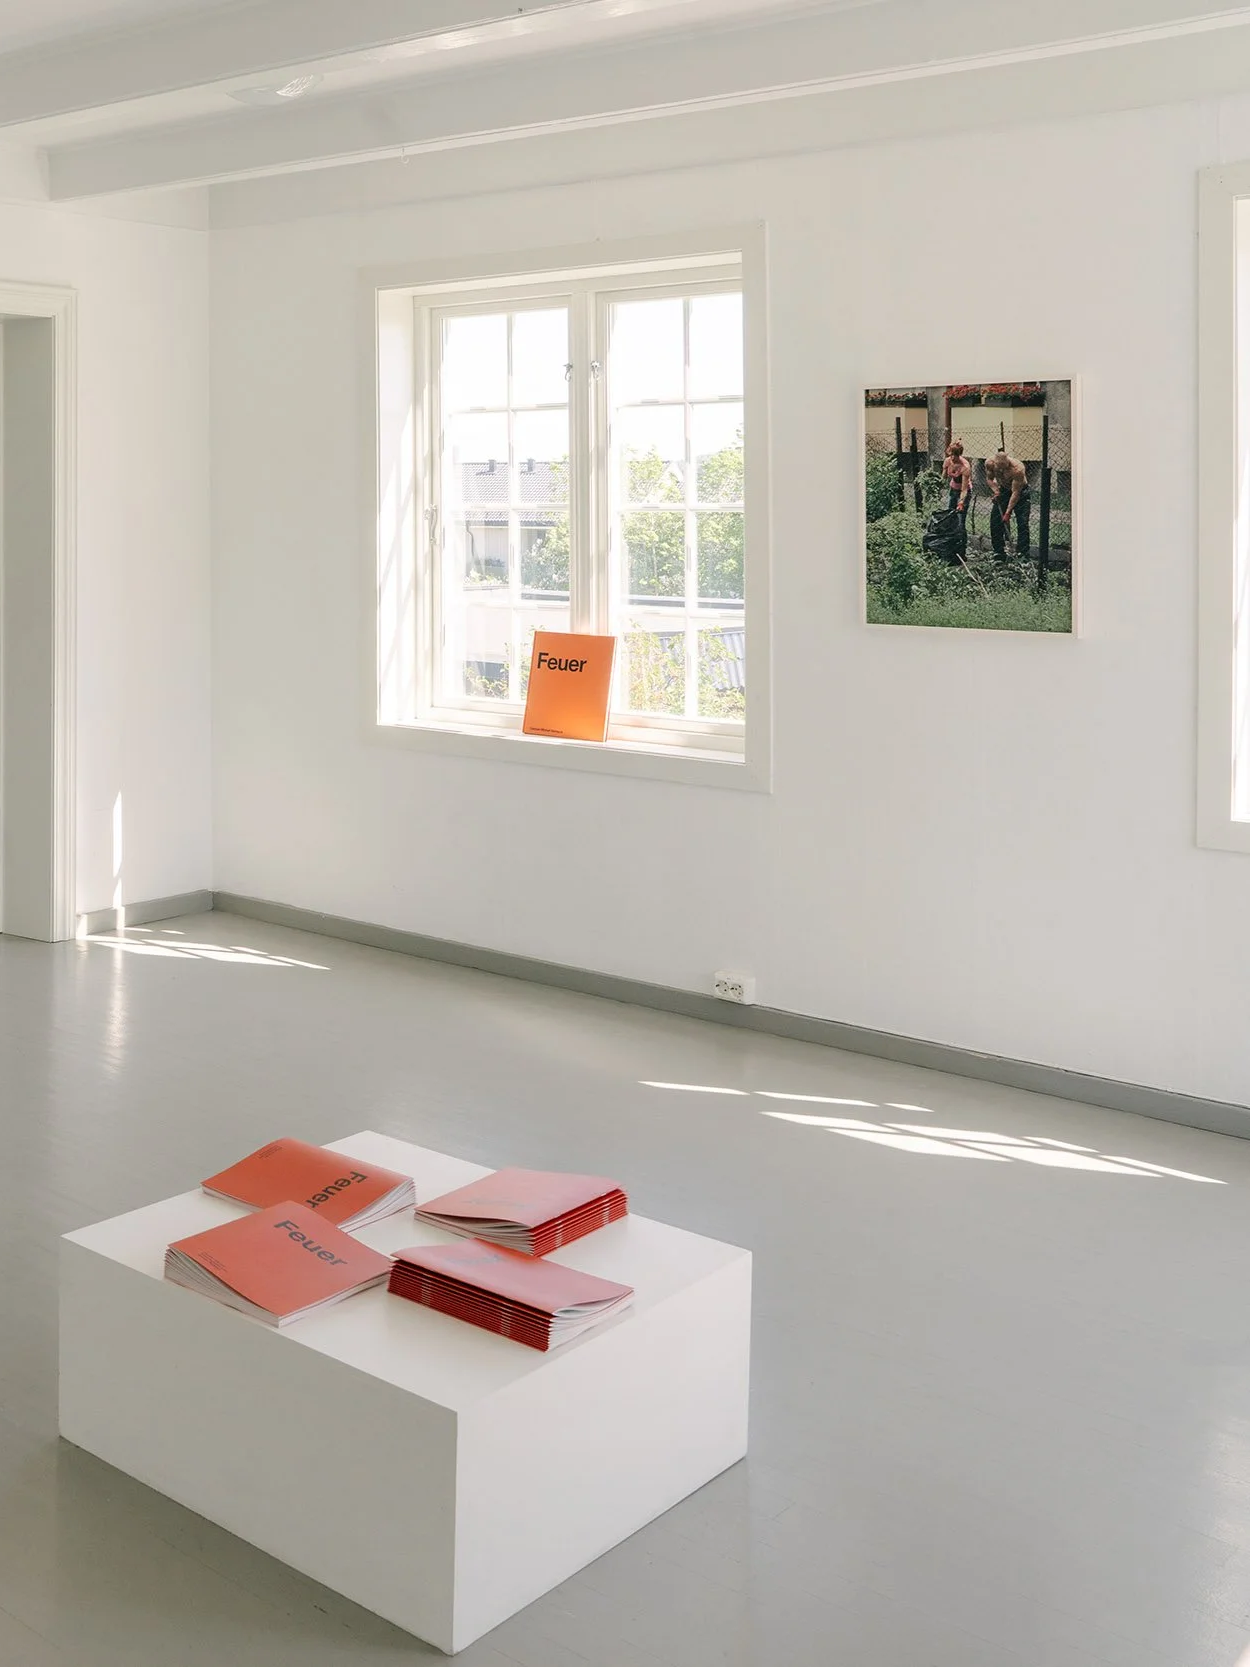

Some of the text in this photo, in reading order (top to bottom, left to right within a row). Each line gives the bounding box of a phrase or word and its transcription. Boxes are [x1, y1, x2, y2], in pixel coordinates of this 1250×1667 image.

[537, 652, 587, 672] Feuer
[306, 1171, 368, 1208] Feuer
[274, 1220, 348, 1265] Feuer
